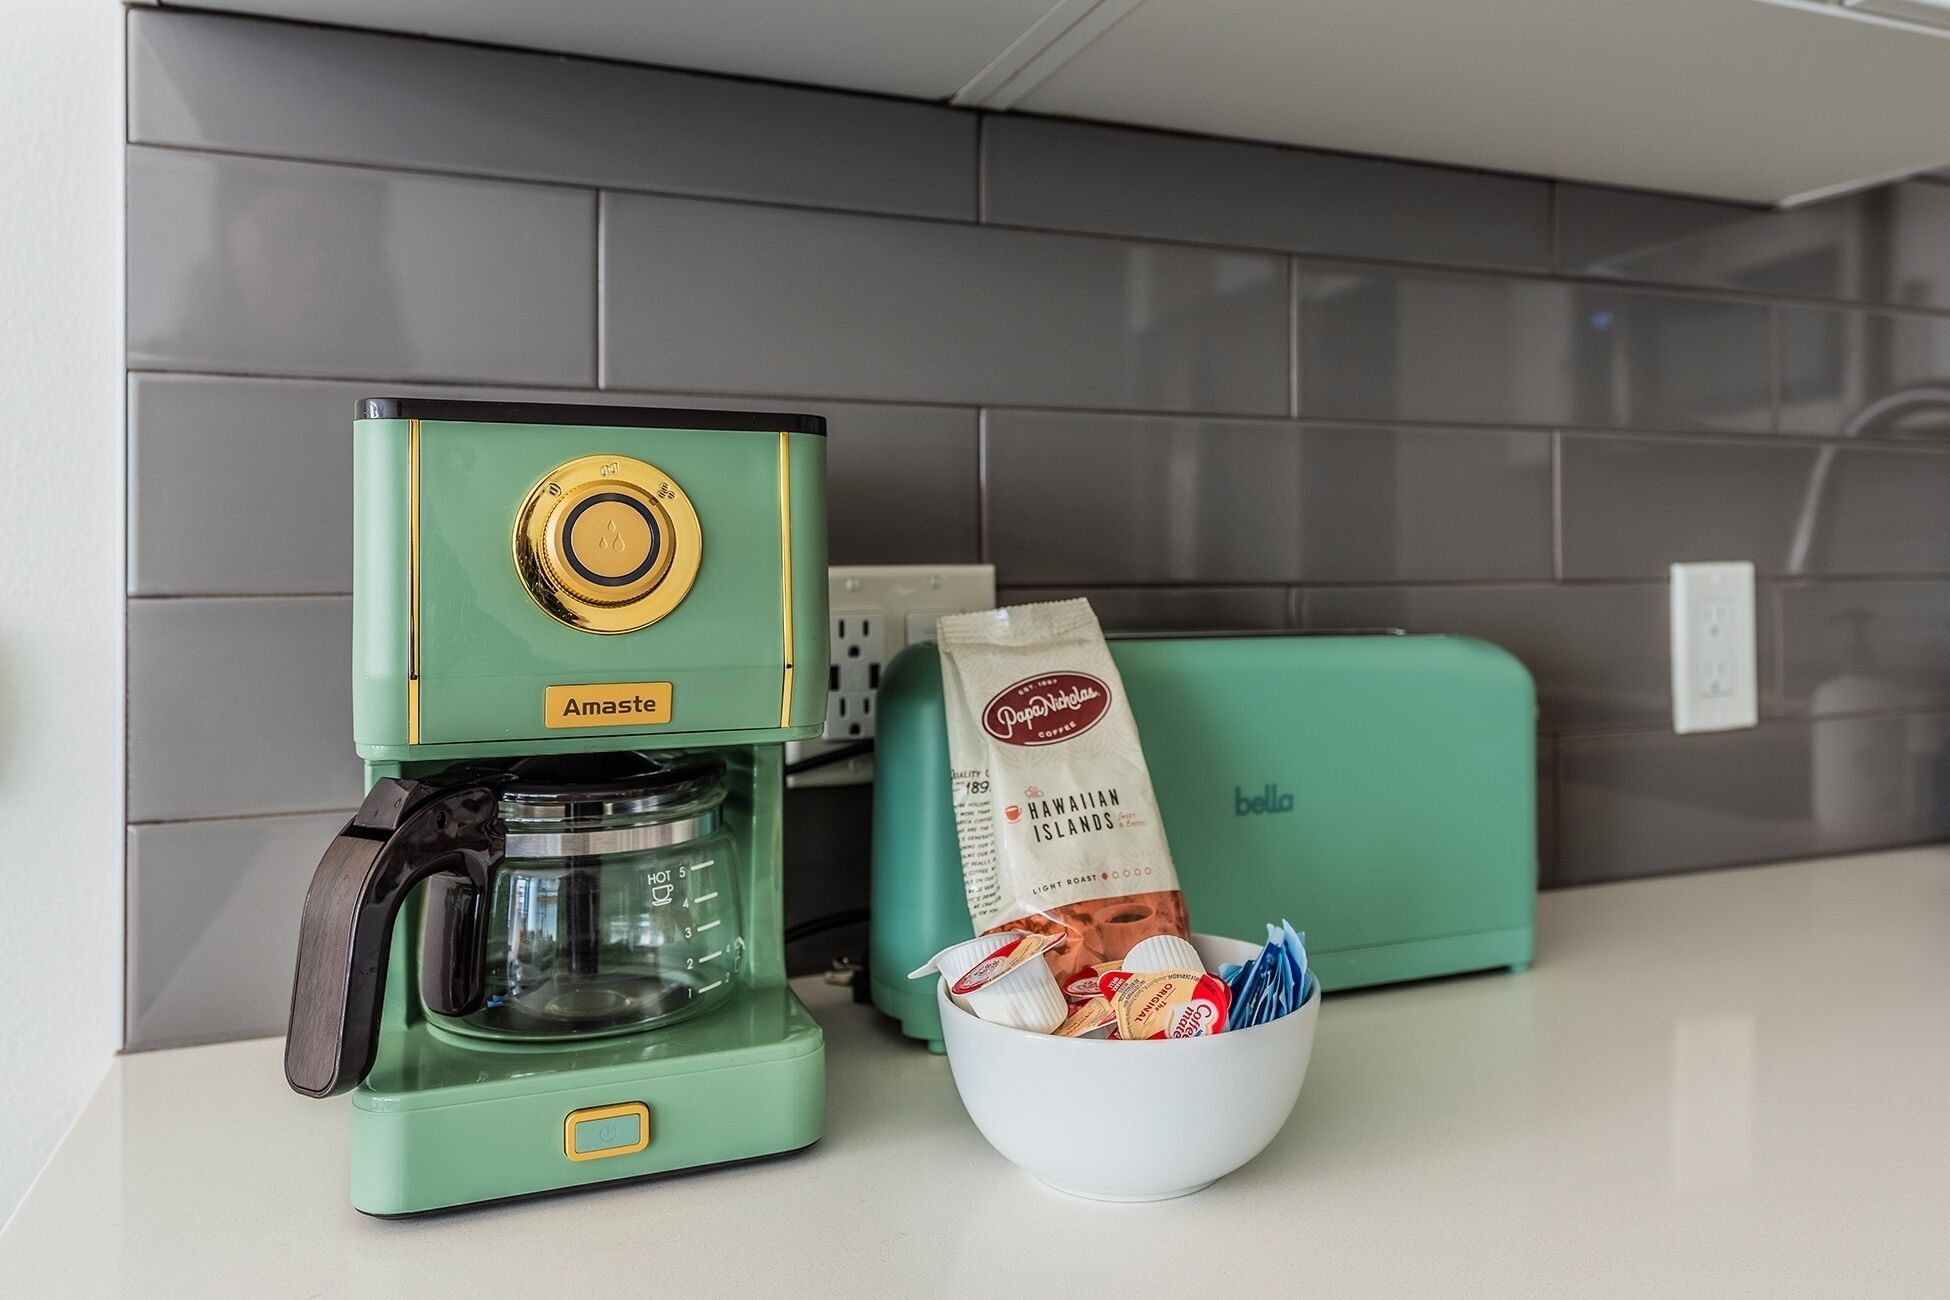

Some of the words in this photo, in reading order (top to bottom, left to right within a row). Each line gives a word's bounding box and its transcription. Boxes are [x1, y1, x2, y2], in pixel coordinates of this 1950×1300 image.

[563, 695, 656, 716] Amaste
[1038, 721, 1077, 738] COFFEE
[966, 781, 991, 795] 189
[1028, 789, 1119, 820] HAWAIIAN
[1234, 783, 1294, 816] bello
[1033, 812, 1114, 843] ISLANDS
[647, 870, 671, 885] HOT
[679, 866, 686, 878] 5
[1032, 882, 1062, 895] LIGHT
[1066, 875, 1097, 885] ROAST
[682, 897, 689, 908] 4
[685, 926, 692, 938] 3
[686, 958, 694, 970] 2
[687, 988, 692, 999] 1
[1135, 983, 1173, 1022] ORIGINAL
[1154, 1000, 1168, 1012] The
[1173, 1006, 1194, 1039] mate
